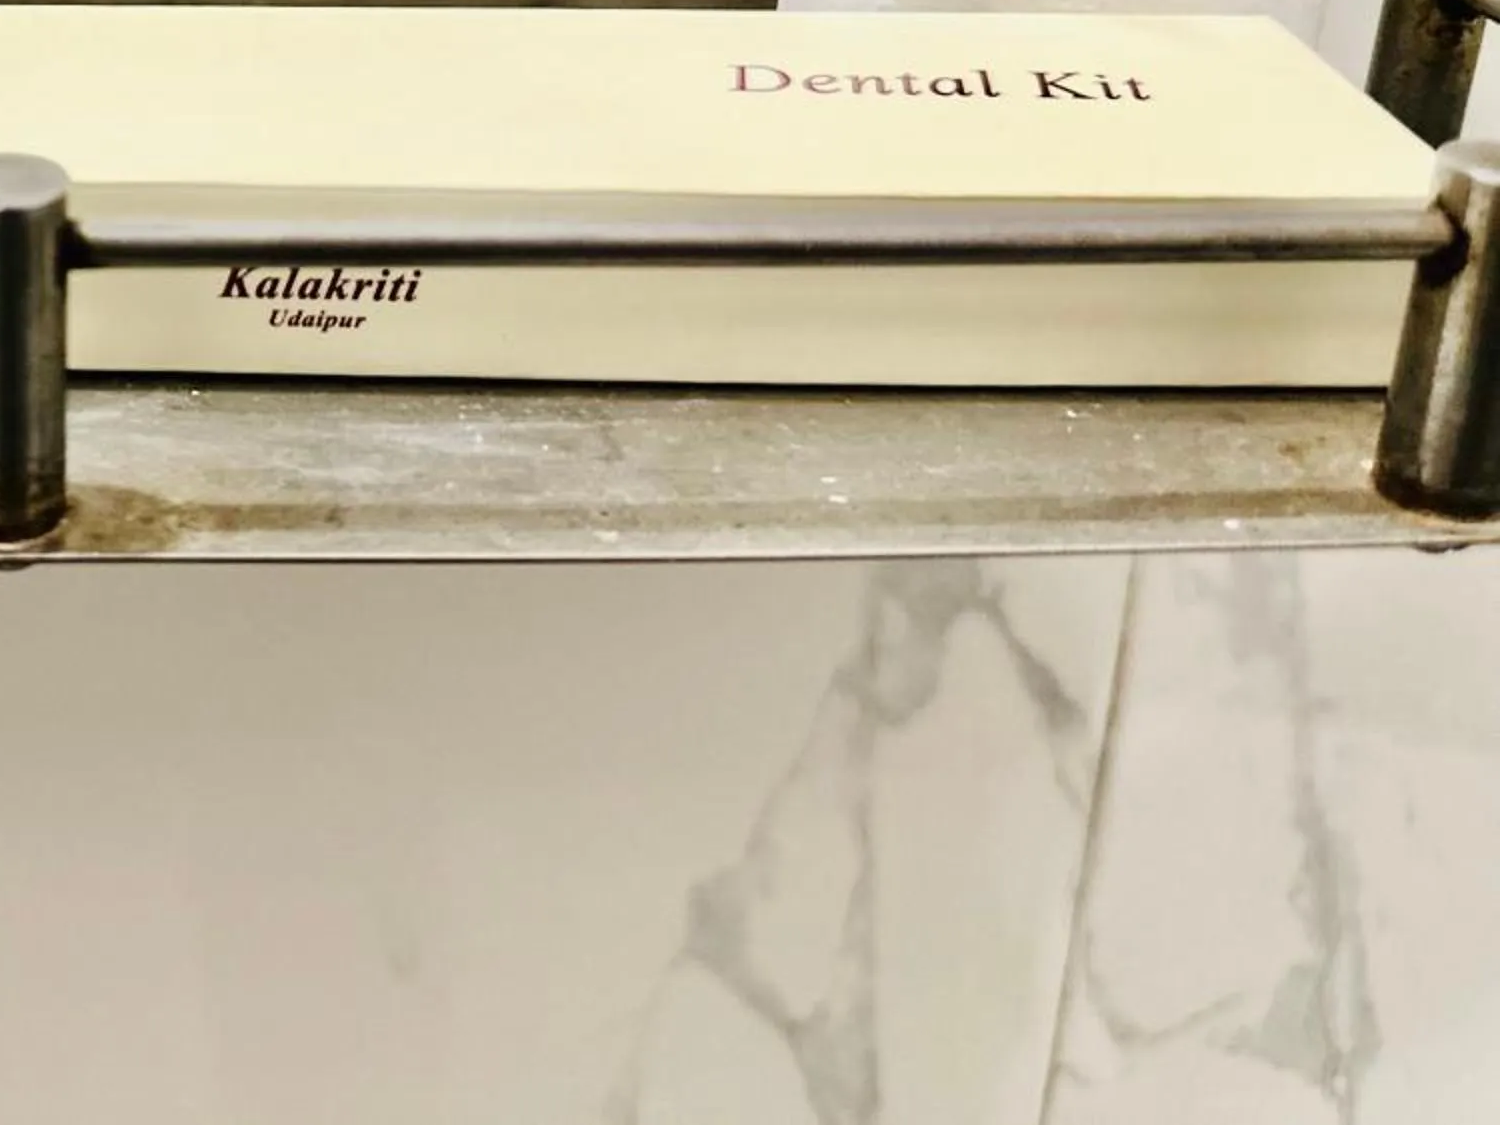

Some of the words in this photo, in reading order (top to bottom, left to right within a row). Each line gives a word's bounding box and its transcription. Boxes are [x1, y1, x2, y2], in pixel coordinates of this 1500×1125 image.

[728, 64, 1001, 98] Dental
[1028, 70, 1152, 101] Kit
[218, 266, 423, 303] Kalakriti
[268, 309, 367, 333] Udaipur
